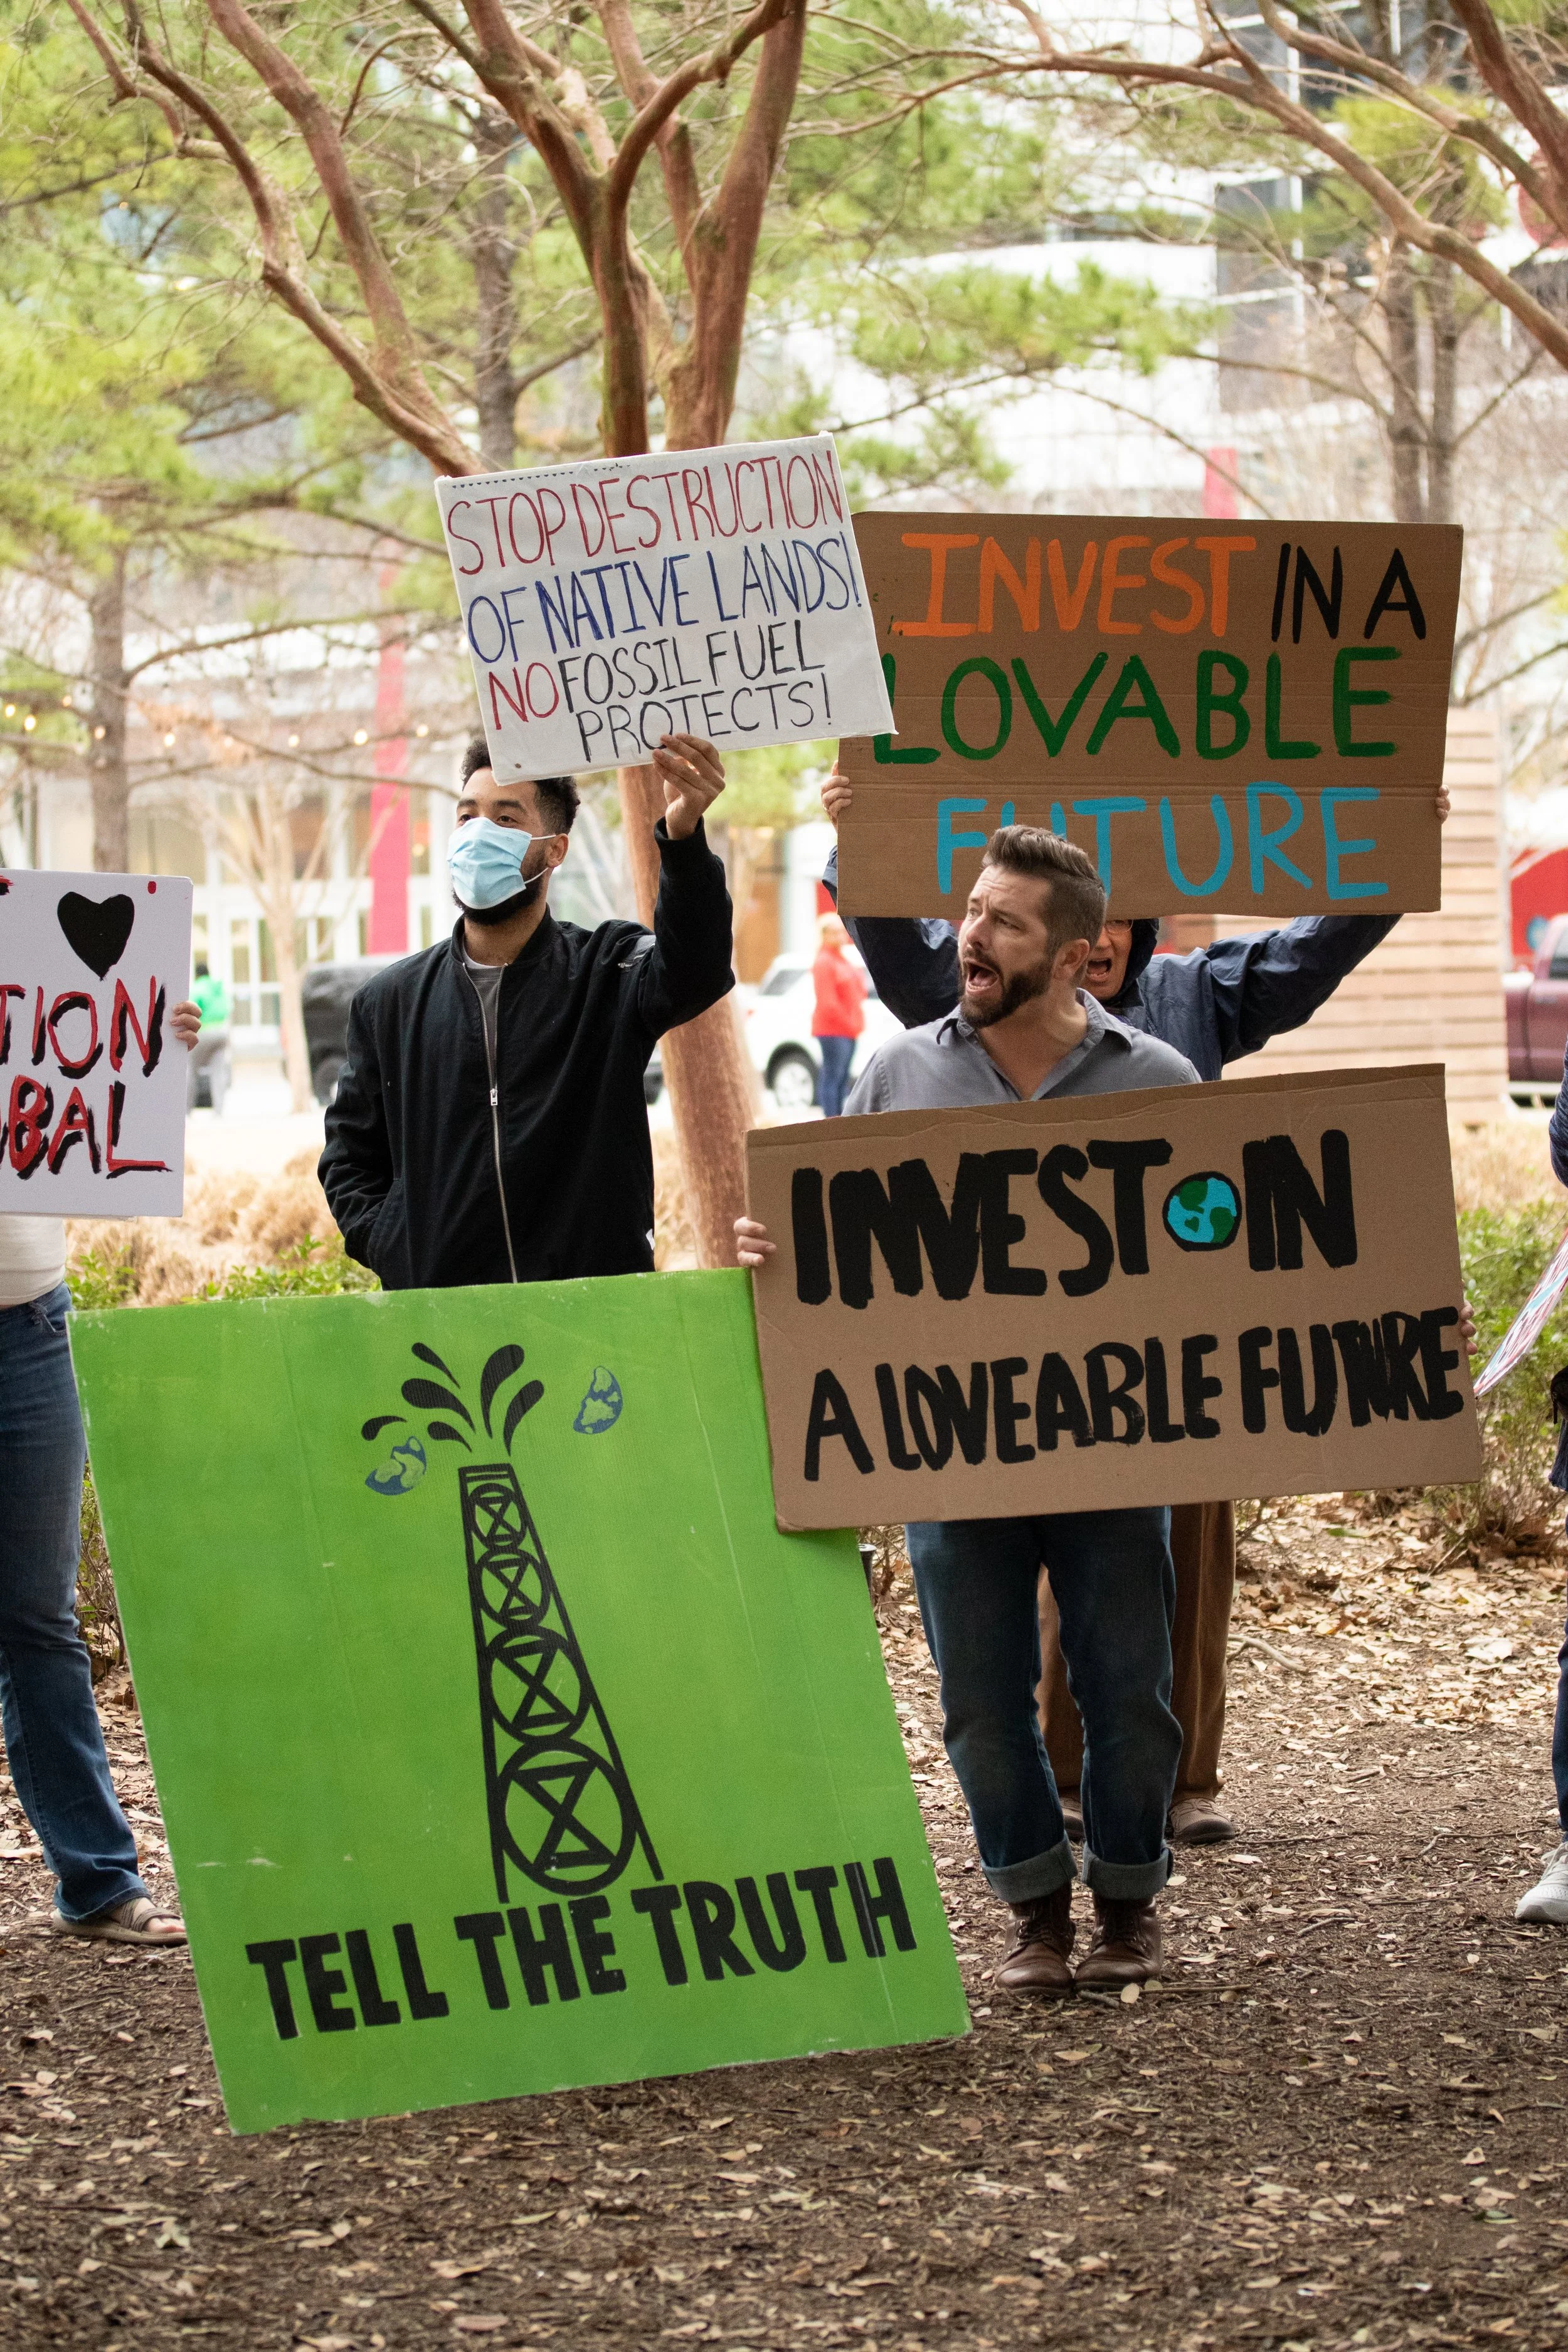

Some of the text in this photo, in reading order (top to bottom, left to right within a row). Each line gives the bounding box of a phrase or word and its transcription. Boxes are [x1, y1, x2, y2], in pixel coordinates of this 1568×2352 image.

[448, 450, 844, 575] STOP DESTRUCTION
[467, 531, 862, 664] OF NATIVE LANDS!
[891, 532, 1427, 644] INVEST IN A
[487, 620, 825, 731] NO FOSSIL FUEL
[576, 672, 832, 763] PROTECTS!
[873, 646, 1402, 765] LOVABLE
[0, 1074, 173, 1180] BAL
[791, 1129, 1358, 1310] INVEST IN
[803, 1368, 875, 1482] A
[875, 1333, 1222, 1472] LOVEABLE
[245, 1857, 918, 2042] TELL THE TRUTH
